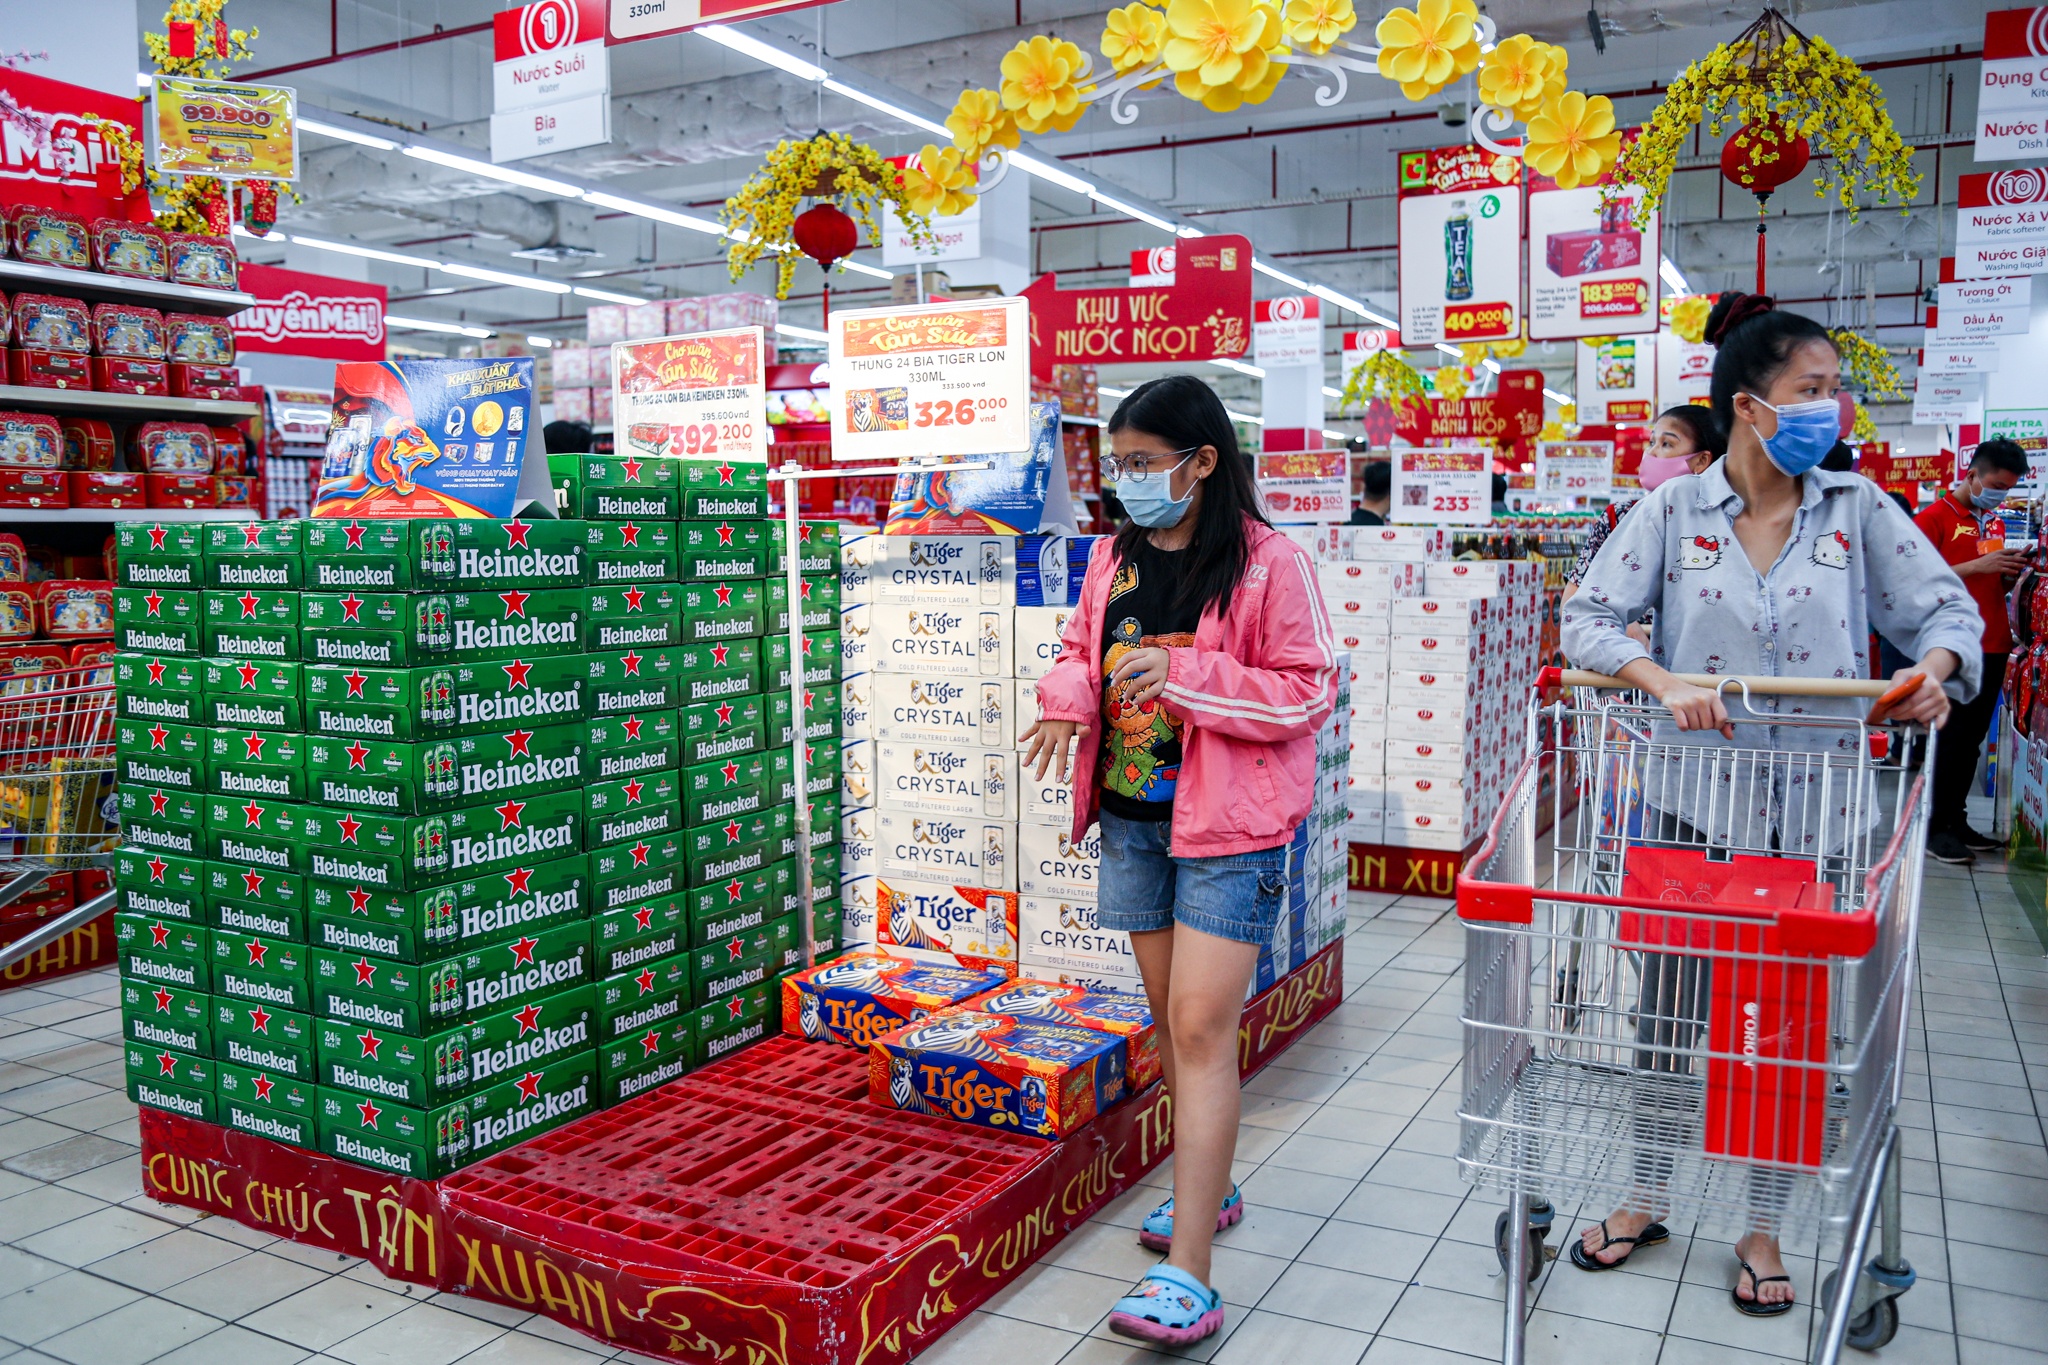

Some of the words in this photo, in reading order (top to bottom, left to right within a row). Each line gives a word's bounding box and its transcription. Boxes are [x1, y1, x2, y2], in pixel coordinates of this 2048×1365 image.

[629, 0, 666, 18] 330ml
[540, 7, 558, 43] 1
[513, 65, 550, 85] Nước
[554, 53, 585, 76] Suối
[1985, 72, 2033, 88] Dụng
[181, 104, 272, 127] 99.900
[535, 115, 556, 131] Bia
[1985, 121, 2038, 138] Nước
[2018, 139, 2043, 150] Dish
[2002, 174, 2038, 200] 10
[1973, 214, 2012, 226] Nước
[2017, 212, 2035, 223] Xả
[1978, 249, 2017, 262] Nước
[2020, 261, 2043, 269] liquid
[1957, 288, 1994, 297] Tương
[1998, 284, 2011, 294] Ớt
[1076, 296, 1119, 324] KHU
[1129, 292, 1169, 327] VỰC
[1963, 313, 1985, 325] Dầu
[1988, 312, 2003, 323] Ăn
[1056, 325, 1123, 356] NƯỚC
[1133, 326, 1200, 359] NGỌT
[851, 357, 893, 370] THÙNG
[897, 358, 910, 367] 24
[938, 353, 975, 365] TIGER
[980, 351, 1005, 362] LON
[909, 371, 945, 383] 330ML
[942, 382, 970, 390] 333.500
[599, 497, 665, 515] Heineken
[698, 498, 756, 514] Heineken
[1433, 496, 1469, 511] 233
[459, 548, 578, 579] Heineken
[924, 542, 963, 566] Tiger
[129, 563, 190, 584] Heineken
[220, 565, 288, 584] Heineken
[320, 566, 394, 585] Heineken
[892, 569, 976, 586] CRYSTAL
[694, 618, 753, 637] Heineken
[924, 612, 962, 635] Tiger
[600, 626, 667, 645] Heineken
[892, 639, 975, 657] CRYSTAL
[925, 682, 963, 705] Tiger
[127, 695, 189, 718] Heineken
[216, 702, 285, 725] Heineken
[459, 689, 579, 724] Heineken
[894, 708, 976, 726] CRYSTAL
[320, 712, 393, 735] Heineken
[697, 736, 754, 759] Heineken
[601, 751, 666, 774] Heineken
[928, 752, 966, 774] Tiger
[897, 776, 980, 796] CRYSTAL
[131, 825, 192, 851] Heineken
[928, 822, 966, 845] Tiger
[222, 839, 289, 867] Heineken
[452, 824, 572, 868] Heineken
[896, 845, 979, 867] CRYSTAL
[313, 856, 387, 884] Heineken
[914, 895, 977, 931] Tiger
[953, 924, 985, 935] CRYSTAL
[1040, 930, 1132, 956] CRYSTAL
[708, 968, 763, 998] Heineken
[1258, 951, 1335, 1052] 2021
[615, 1000, 678, 1034] Heineken
[825, 998, 903, 1047] Tiger
[138, 1085, 202, 1115] Heineken
[920, 1063, 1012, 1120] Tiger
[1022, 1096, 1044, 1112] Tiger
[231, 1108, 301, 1142] Heineken
[473, 1087, 588, 1149] Heineken
[336, 1135, 410, 1172] Heineken
[981, 1200, 1054, 1279] CUNG
[1062, 1138, 1126, 1216] CHÚC
[1135, 1084, 1175, 1167] TÂ
[148, 1152, 233, 1210] CUNG
[246, 1180, 335, 1240] CHÚC
[342, 1185, 438, 1278] TÂN
[457, 1231, 618, 1339] XUÂN
